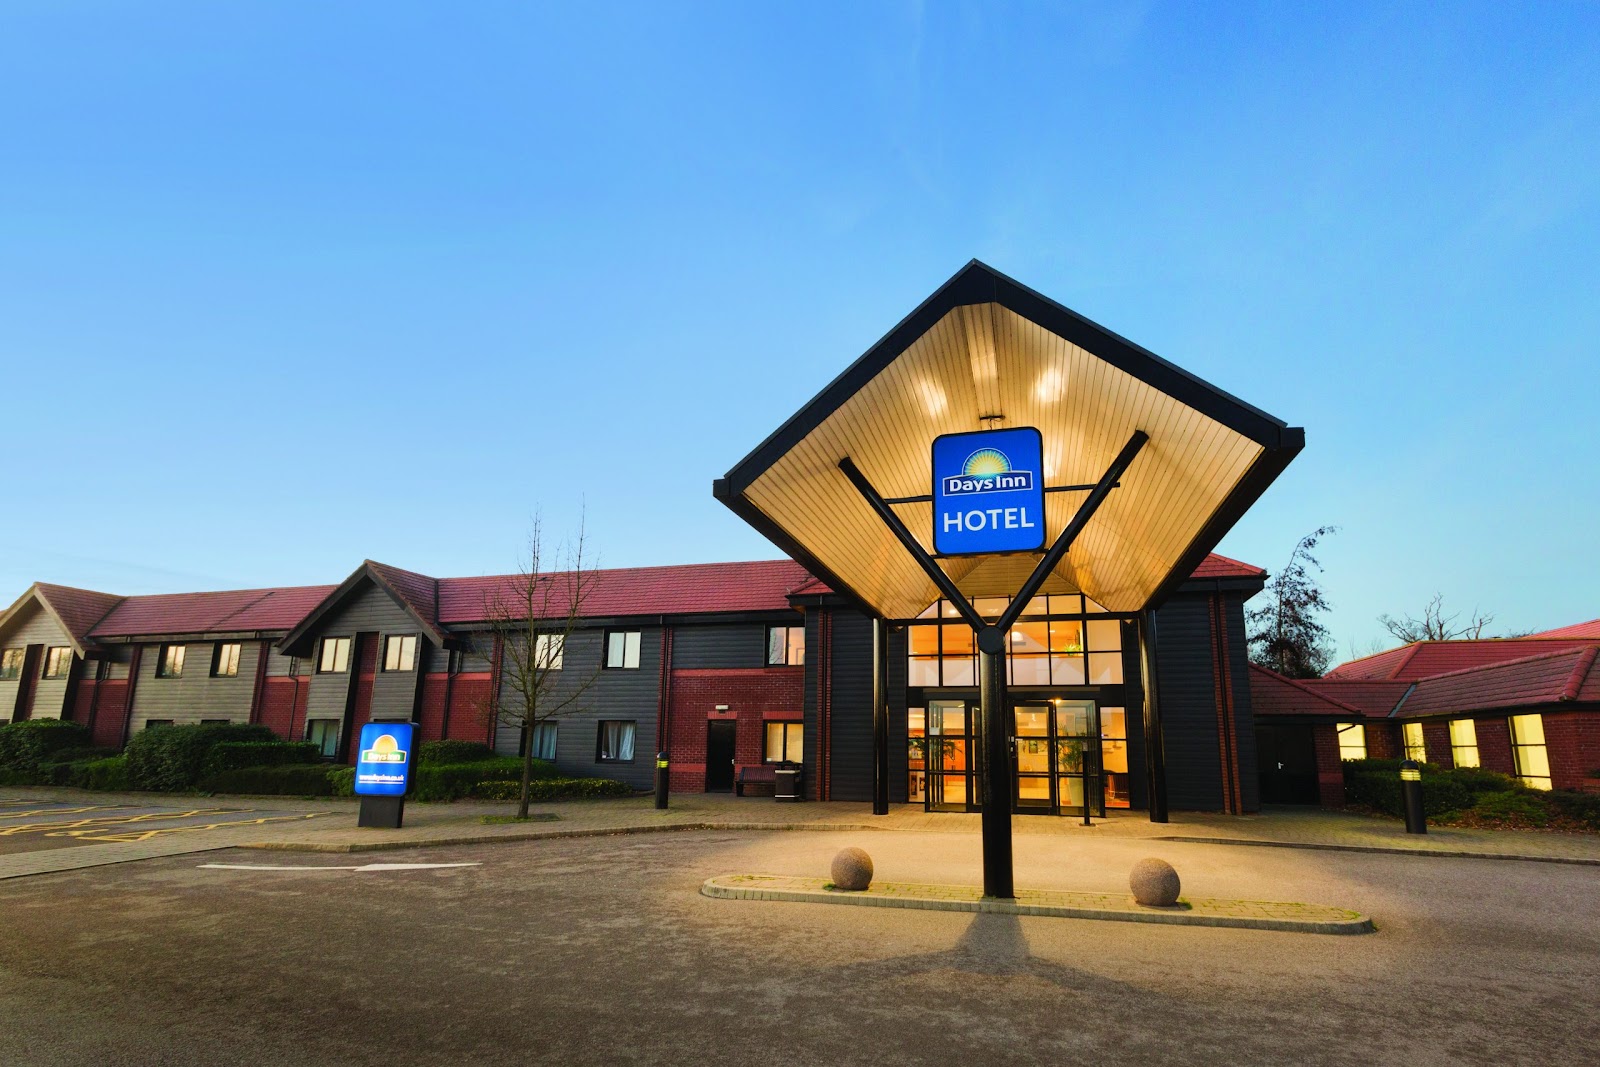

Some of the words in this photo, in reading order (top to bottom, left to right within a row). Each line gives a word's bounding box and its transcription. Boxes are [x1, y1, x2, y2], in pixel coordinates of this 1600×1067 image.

[949, 479, 993, 492] Days
[995, 476, 1027, 489] Inn
[943, 507, 1035, 533] HOTEL
[367, 752, 387, 761] Days
